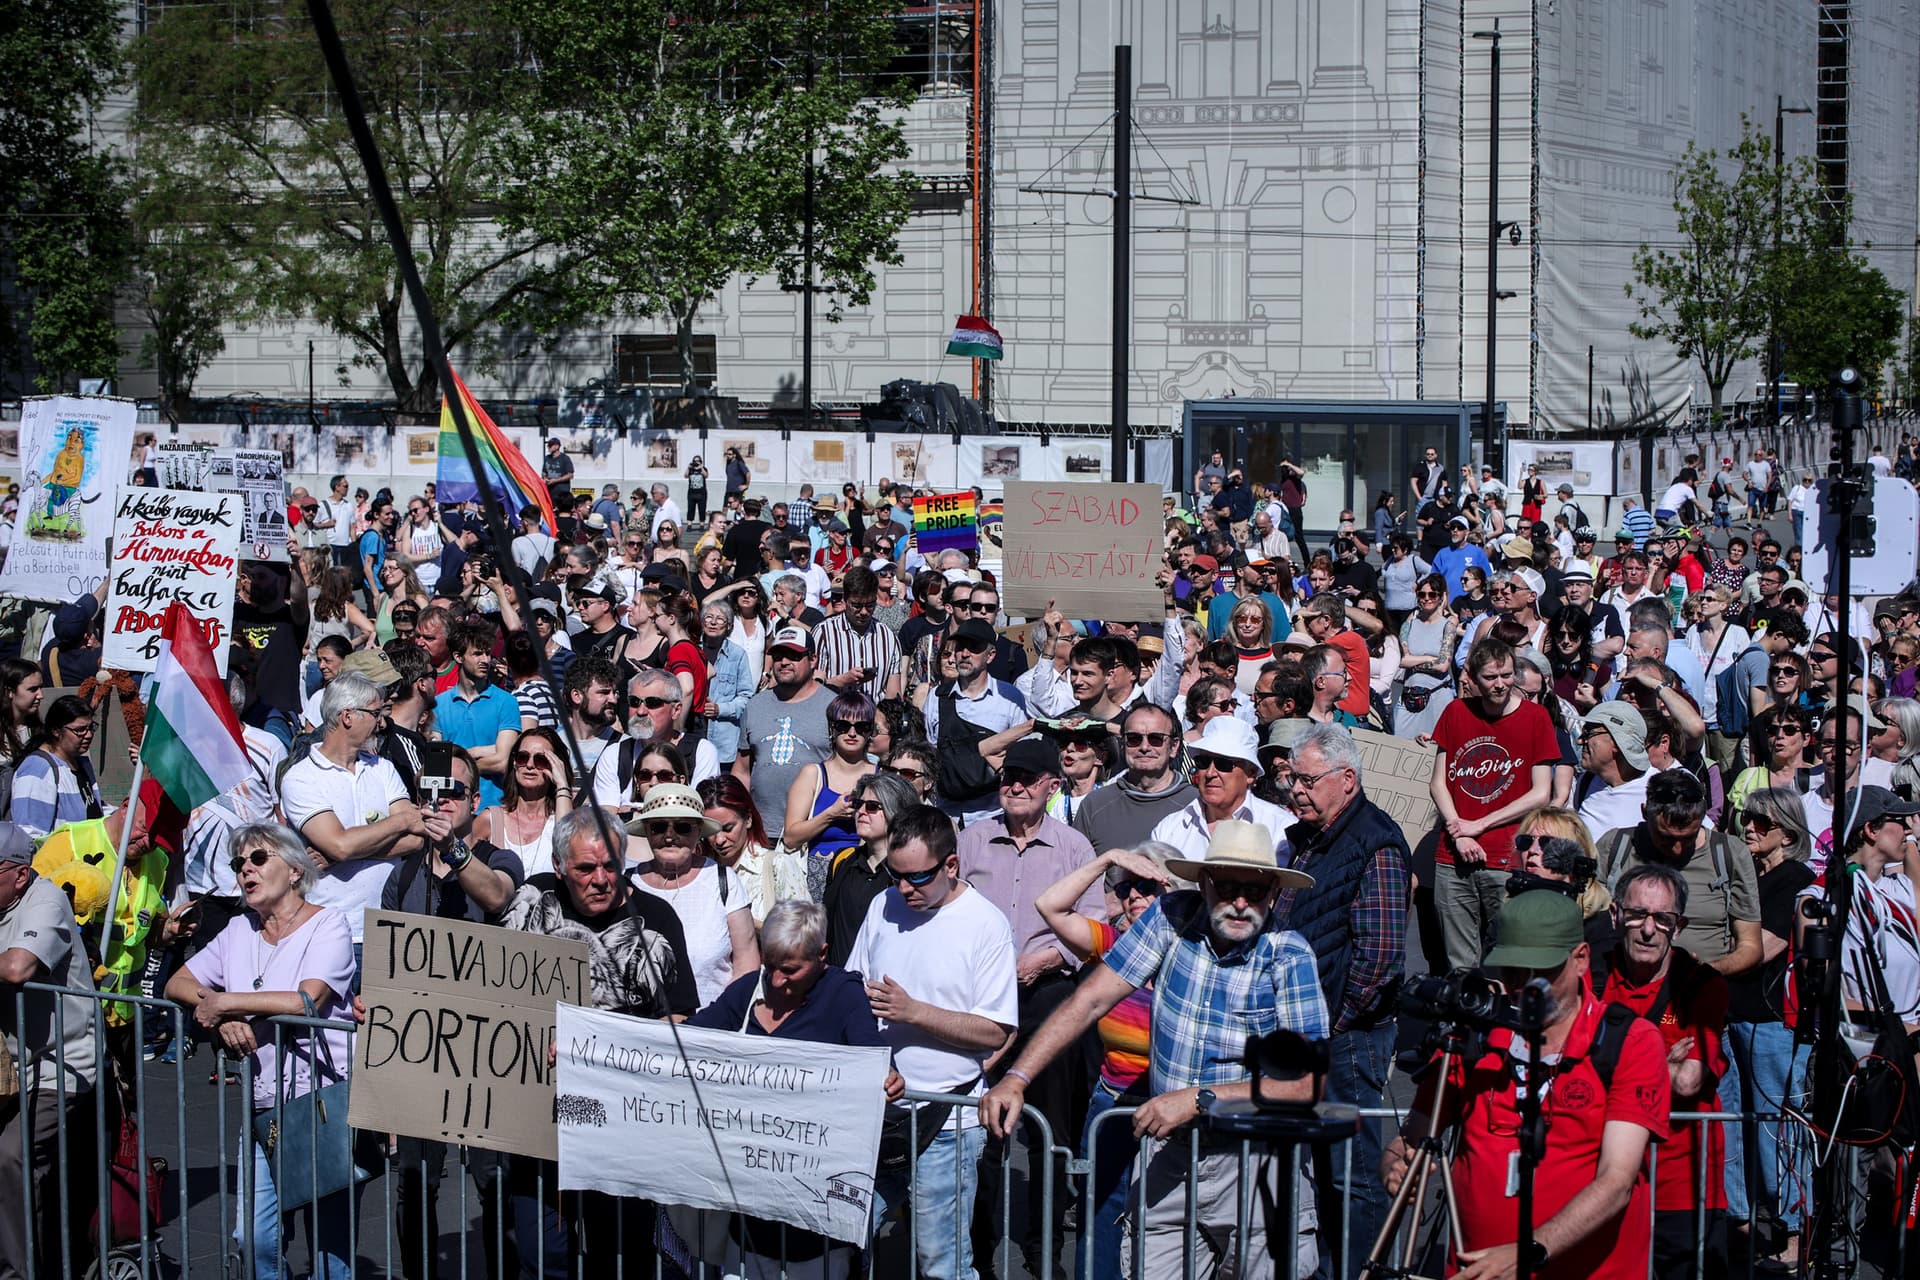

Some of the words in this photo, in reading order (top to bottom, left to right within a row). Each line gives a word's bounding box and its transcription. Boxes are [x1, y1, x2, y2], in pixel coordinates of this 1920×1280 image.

[926, 496, 959, 514] FREE
[1031, 490, 1141, 527] SZABAD
[926, 514, 968, 531] PRIDE
[191, 528, 210, 539] a
[1006, 538, 1153, 580] VÁLASZTÁST!
[152, 563, 197, 580] mint
[200, 592, 223, 609] a
[1448, 760, 1476, 782] San
[1475, 757, 1524, 779] Diego
[604, 1043, 665, 1076] ADDIG
[671, 1056, 758, 1087] LESZÜNK
[762, 1064, 815, 1094] KINT
[696, 1108, 743, 1131] NEM
[749, 1114, 830, 1148] LESZTEK
